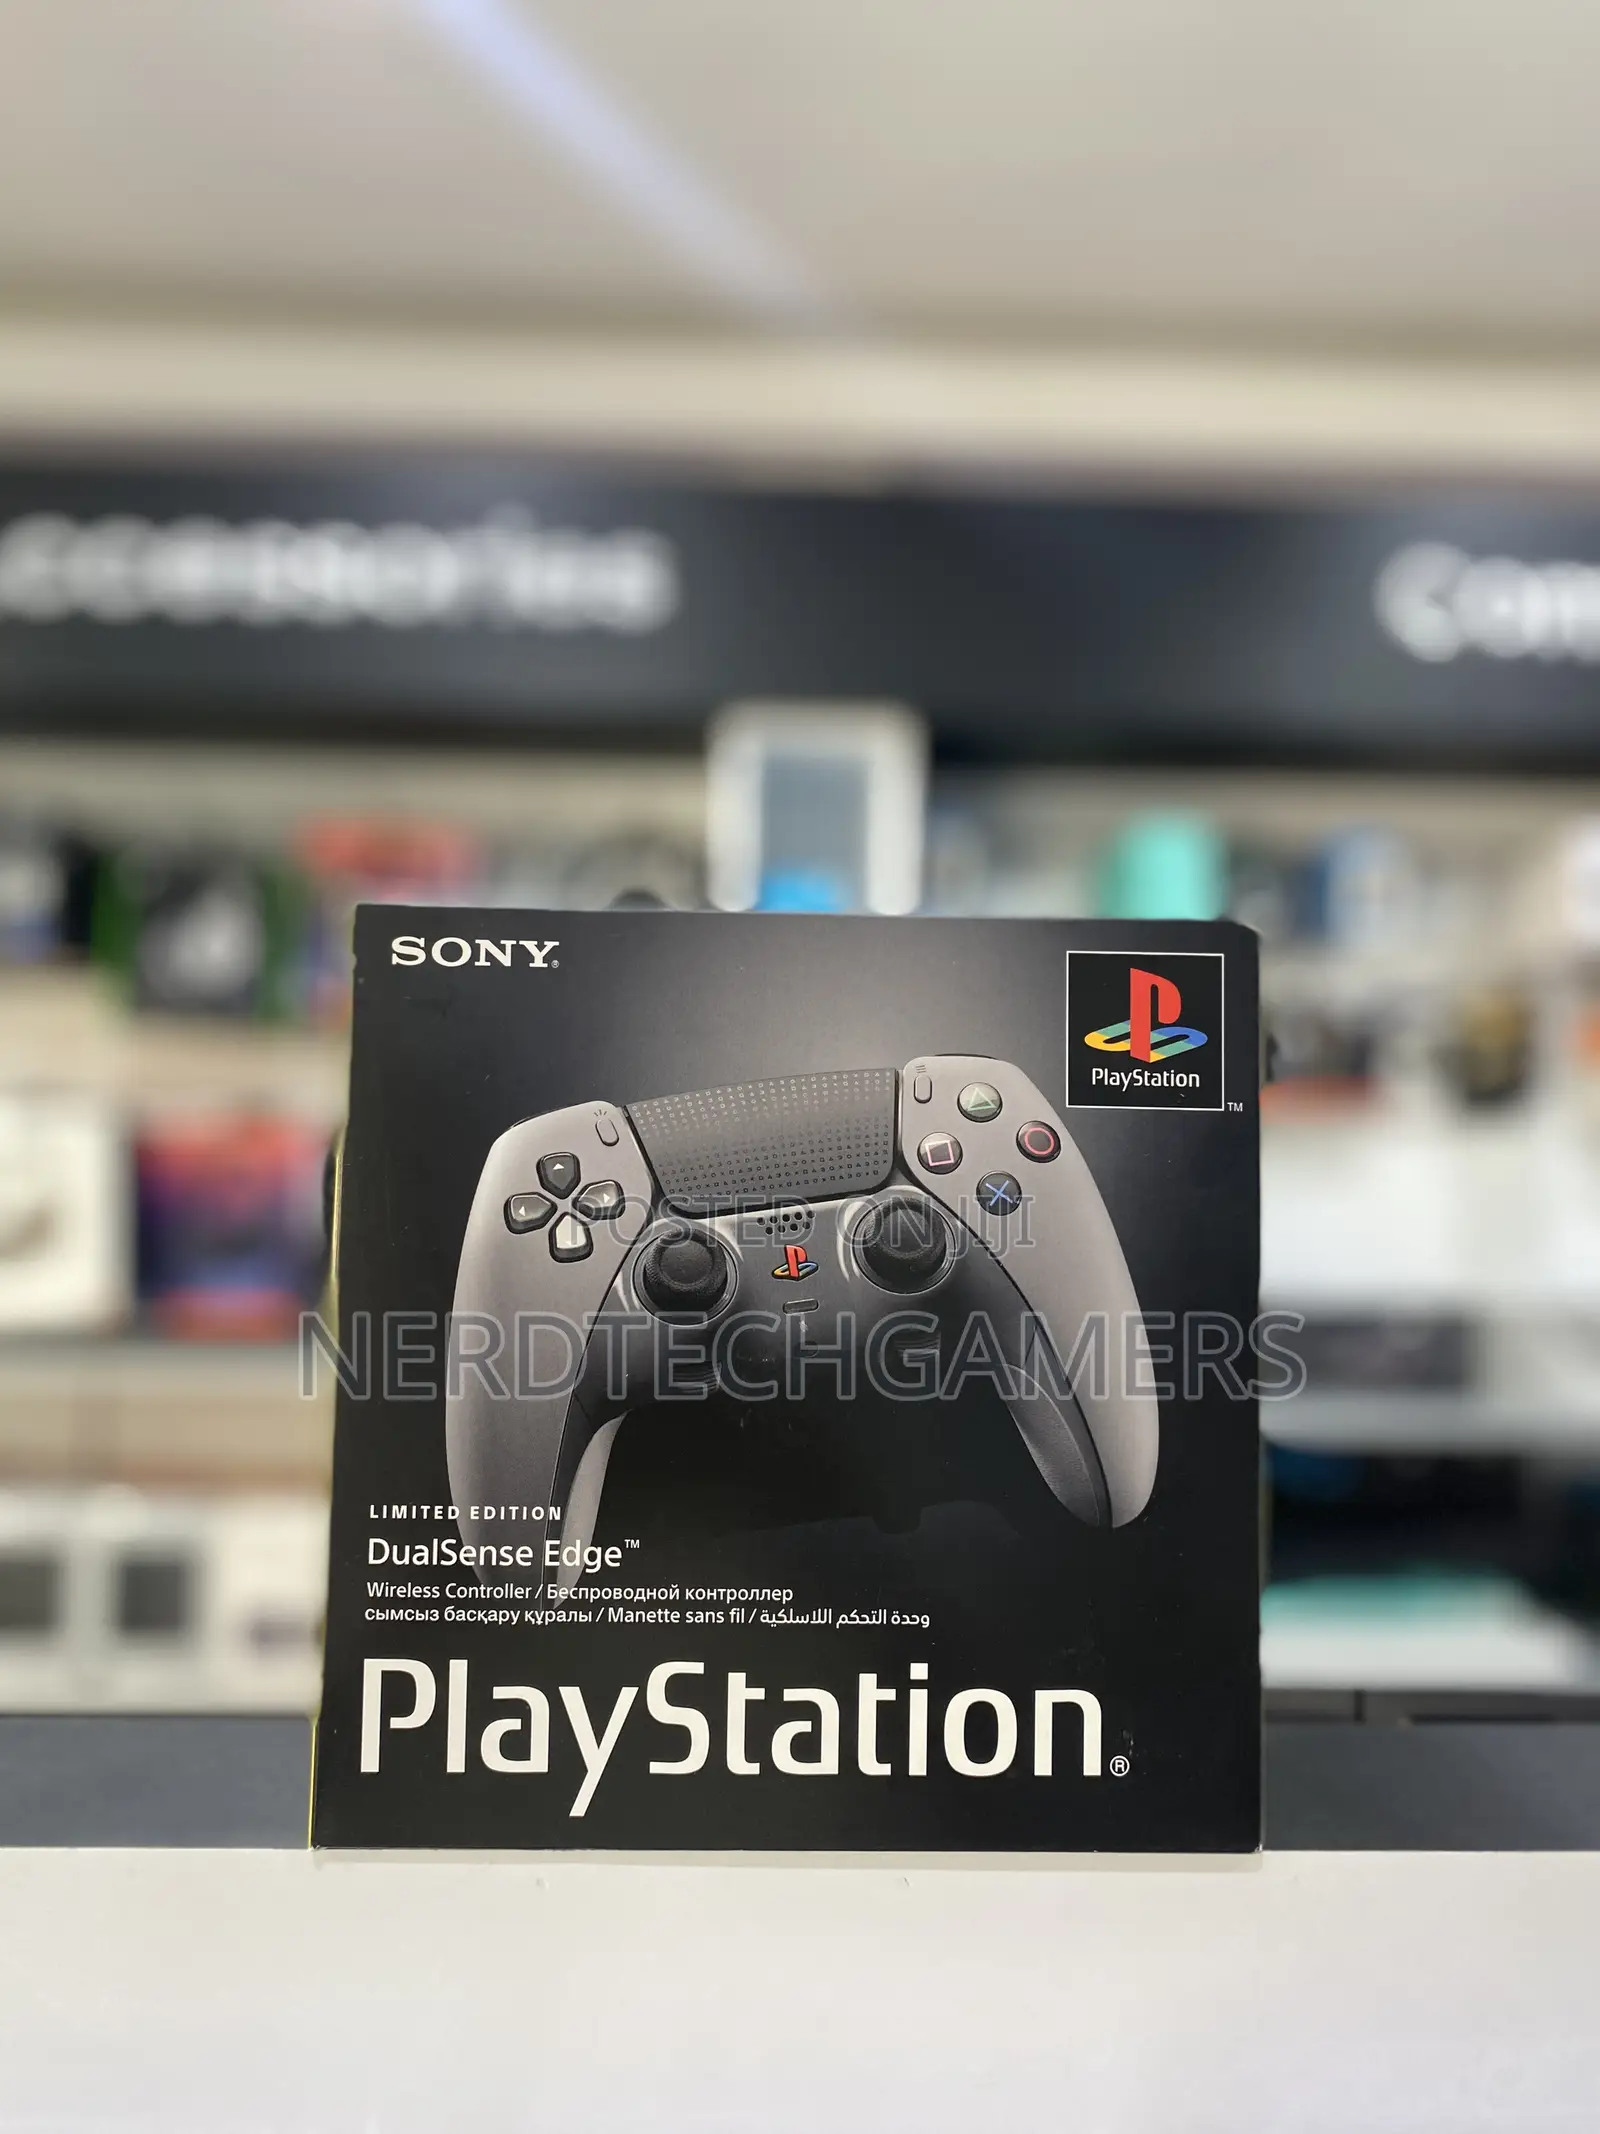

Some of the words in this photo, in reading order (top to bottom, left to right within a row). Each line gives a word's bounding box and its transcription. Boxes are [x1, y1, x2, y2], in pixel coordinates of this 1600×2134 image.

[1092, 1068, 1200, 1092] PlayStation
[369, 1504, 460, 1520] LIMITED
[470, 1505, 563, 1521] EDITION
[367, 1537, 534, 1567] DualSense
[366, 1581, 441, 1599] Wireless
[445, 1582, 532, 1600] Controller
[547, 1583, 681, 1603] Беспроводной
[685, 1586, 794, 1605] контроллер
[364, 1606, 440, 1622] сымсыз
[444, 1605, 520, 1625] басқару
[524, 1608, 593, 1626] құралы
[608, 1606, 681, 1624] Manette
[685, 1609, 726, 1624] sans
[729, 1608, 746, 1625] fil
[759, 1607, 833, 1629] اللاسلكية
[835, 1608, 888, 1630] التحكم
[890, 1609, 932, 1629] وحدة
